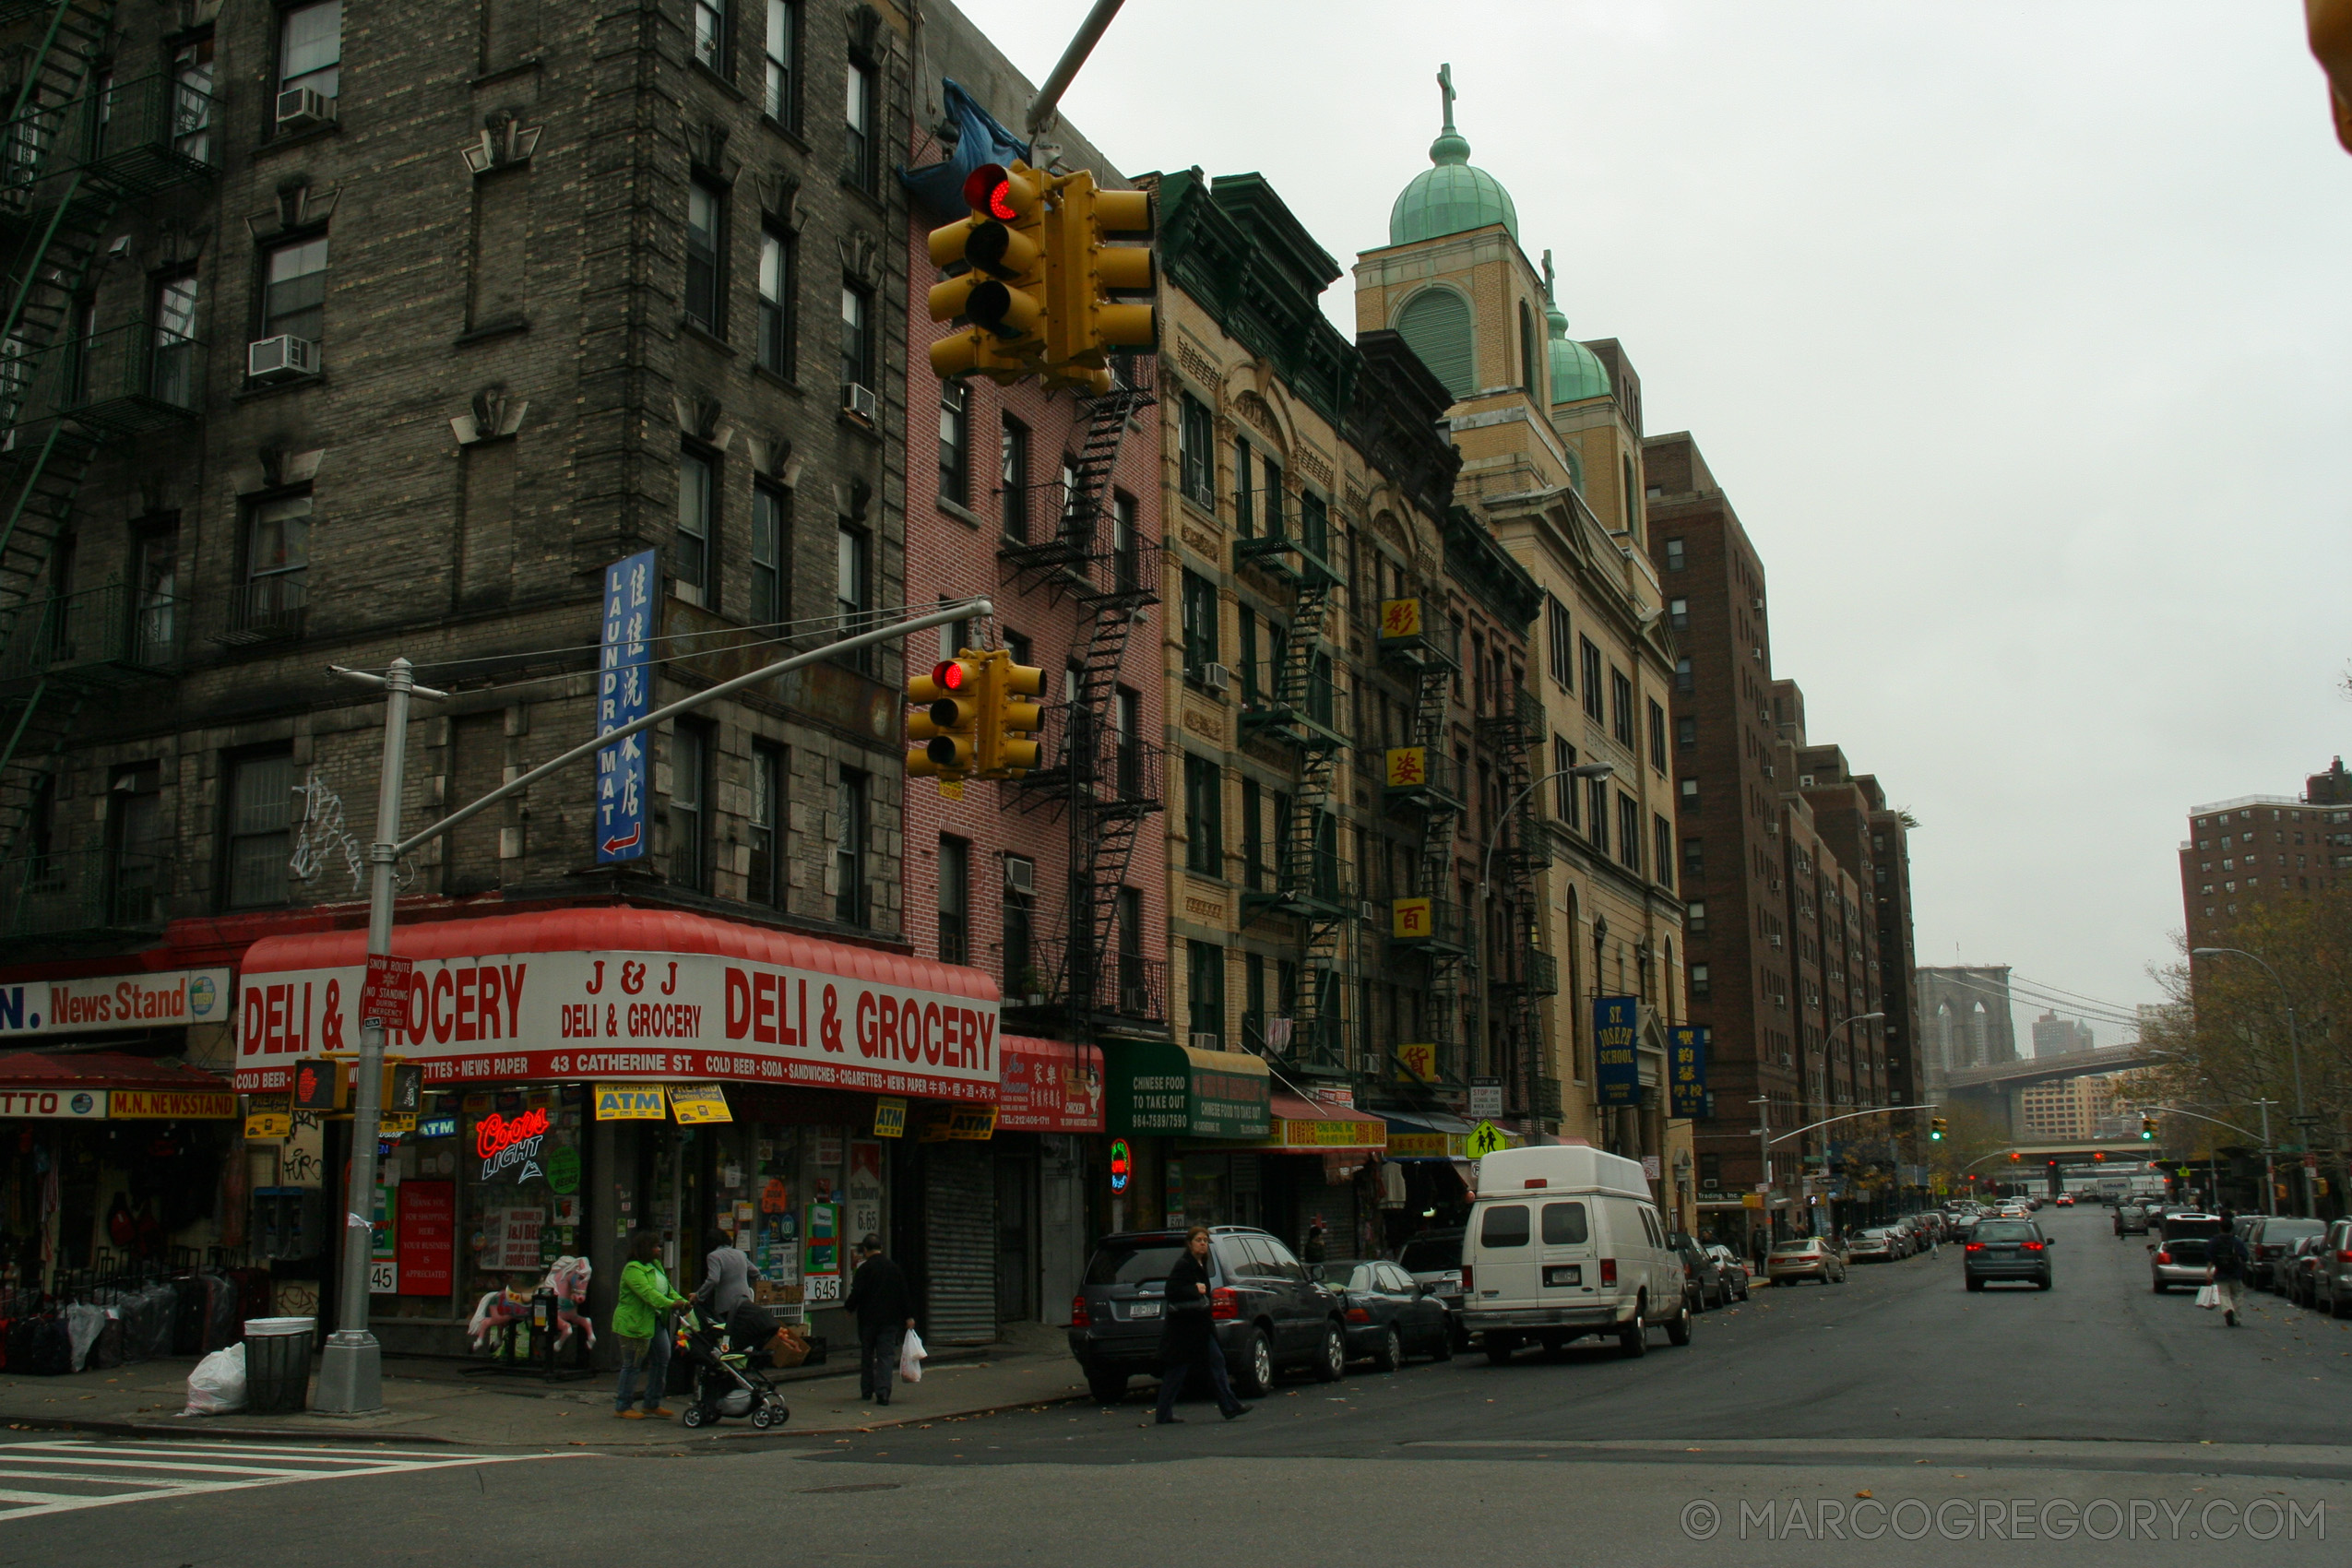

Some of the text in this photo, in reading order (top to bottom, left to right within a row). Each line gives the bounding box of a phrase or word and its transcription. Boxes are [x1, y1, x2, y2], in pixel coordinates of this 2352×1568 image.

[1385, 603, 1414, 635] 彩
[622, 564, 647, 817] 佳佳洗衣店
[1396, 905, 1426, 931] 百
[369, 959, 411, 973] SNOW ROUTE
[586, 960, 678, 995] J & J
[51, 987, 112, 1025] News
[115, 978, 185, 1020] Stand
[365, 987, 409, 1001] NO STANDING
[244, 963, 527, 1055] DELI & OCERY
[368, 1007, 403, 1016] EMERGENCY
[725, 967, 995, 1071] DELI & GROCERY
[1610, 1005, 1622, 1023] ST.
[562, 1003, 701, 1038] DELI & GROCERY
[1598, 1027, 1633, 1047] JOSEPH
[461, 1059, 491, 1076] NEWS
[493, 1057, 528, 1075] PAPER
[550, 1053, 694, 1073] 43 CATHERINE ST.
[1600, 1049, 1633, 1064] SCHOOL
[235, 1071, 285, 1089] COLD BEER
[706, 1055, 927, 1093] COLD BEER SODA SANDWICHES CIGARETTES NEWS PAPER
[1133, 1076, 1164, 1090] CHINESE
[1165, 1075, 1185, 1090] FOOD
[115, 1093, 148, 1114] M.N.
[150, 1092, 233, 1115] NEWSSTAND
[599, 1093, 661, 1110] ATM
[1133, 1095, 1185, 1110] TO TAKE OUT
[876, 1108, 903, 1127] ATM
[951, 1115, 992, 1131] ATM
[418, 1120, 455, 1136] ATM
[476, 1108, 550, 1158] Coors
[481, 1134, 543, 1181] LIGHT
[858, 1210, 876, 1230] 6.65
[524, 1224, 540, 1240] DEL
[526, 1253, 540, 1267] LIGH
[372, 1267, 392, 1289] 45
[405, 1269, 447, 1278] APPRECIATED
[814, 1280, 837, 1300] 645
